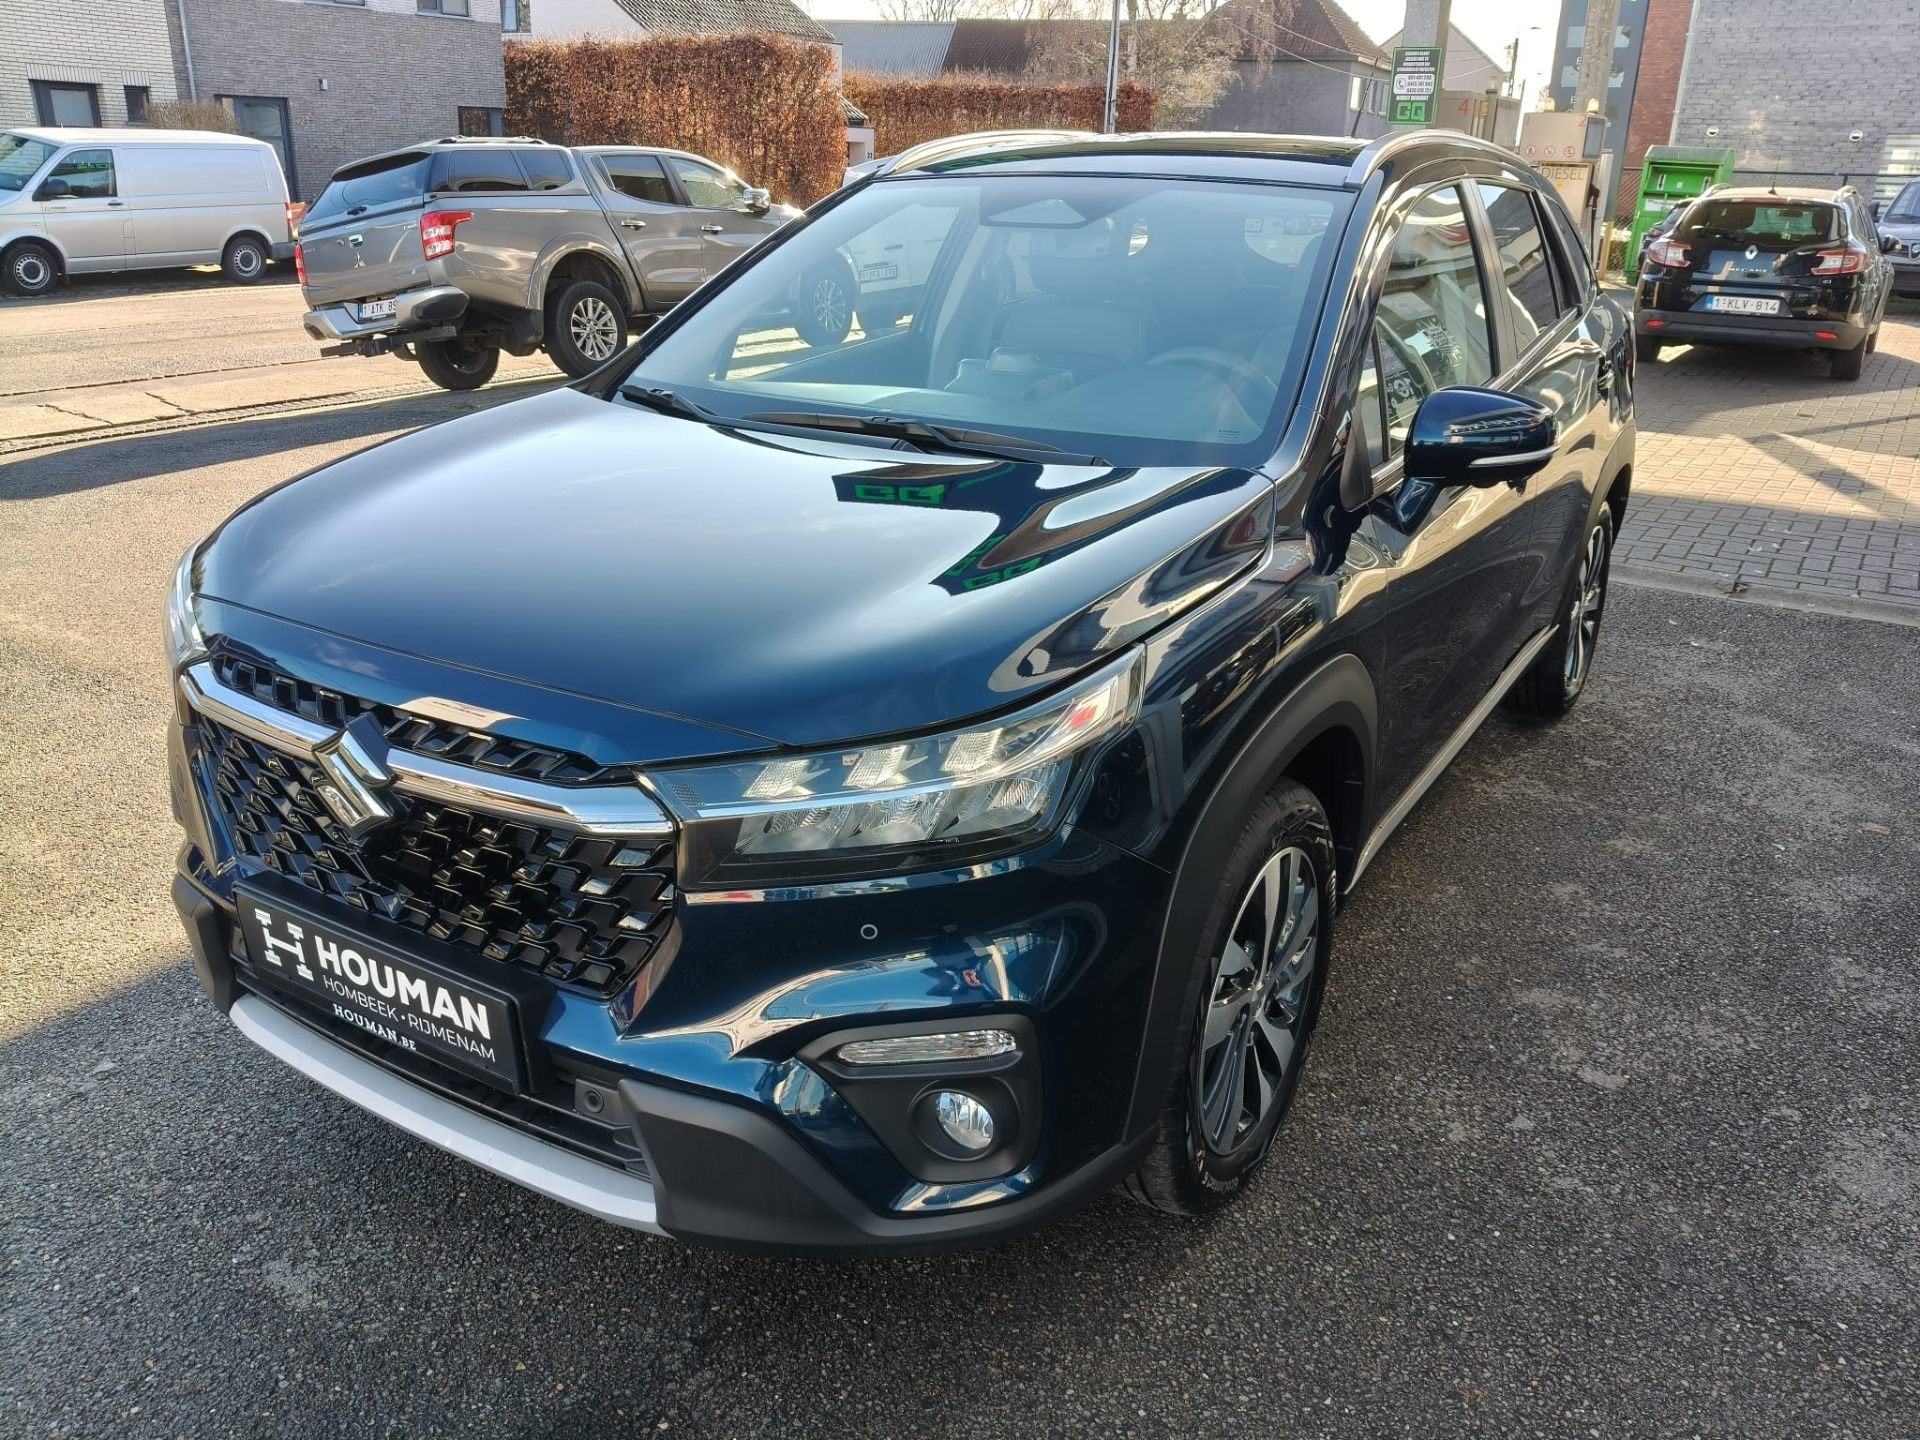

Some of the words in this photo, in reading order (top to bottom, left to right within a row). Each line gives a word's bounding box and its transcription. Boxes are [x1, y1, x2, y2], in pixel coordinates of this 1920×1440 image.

[1457, 98, 1470, 113] 4
[1541, 167, 1585, 180] DIESEL
[314, 935, 491, 1040] HOUMAN
[322, 974, 399, 1021] HOMBEEK
[406, 1013, 496, 1063] RIJMENAM
[333, 1003, 416, 1051] HOUMAN.BE
